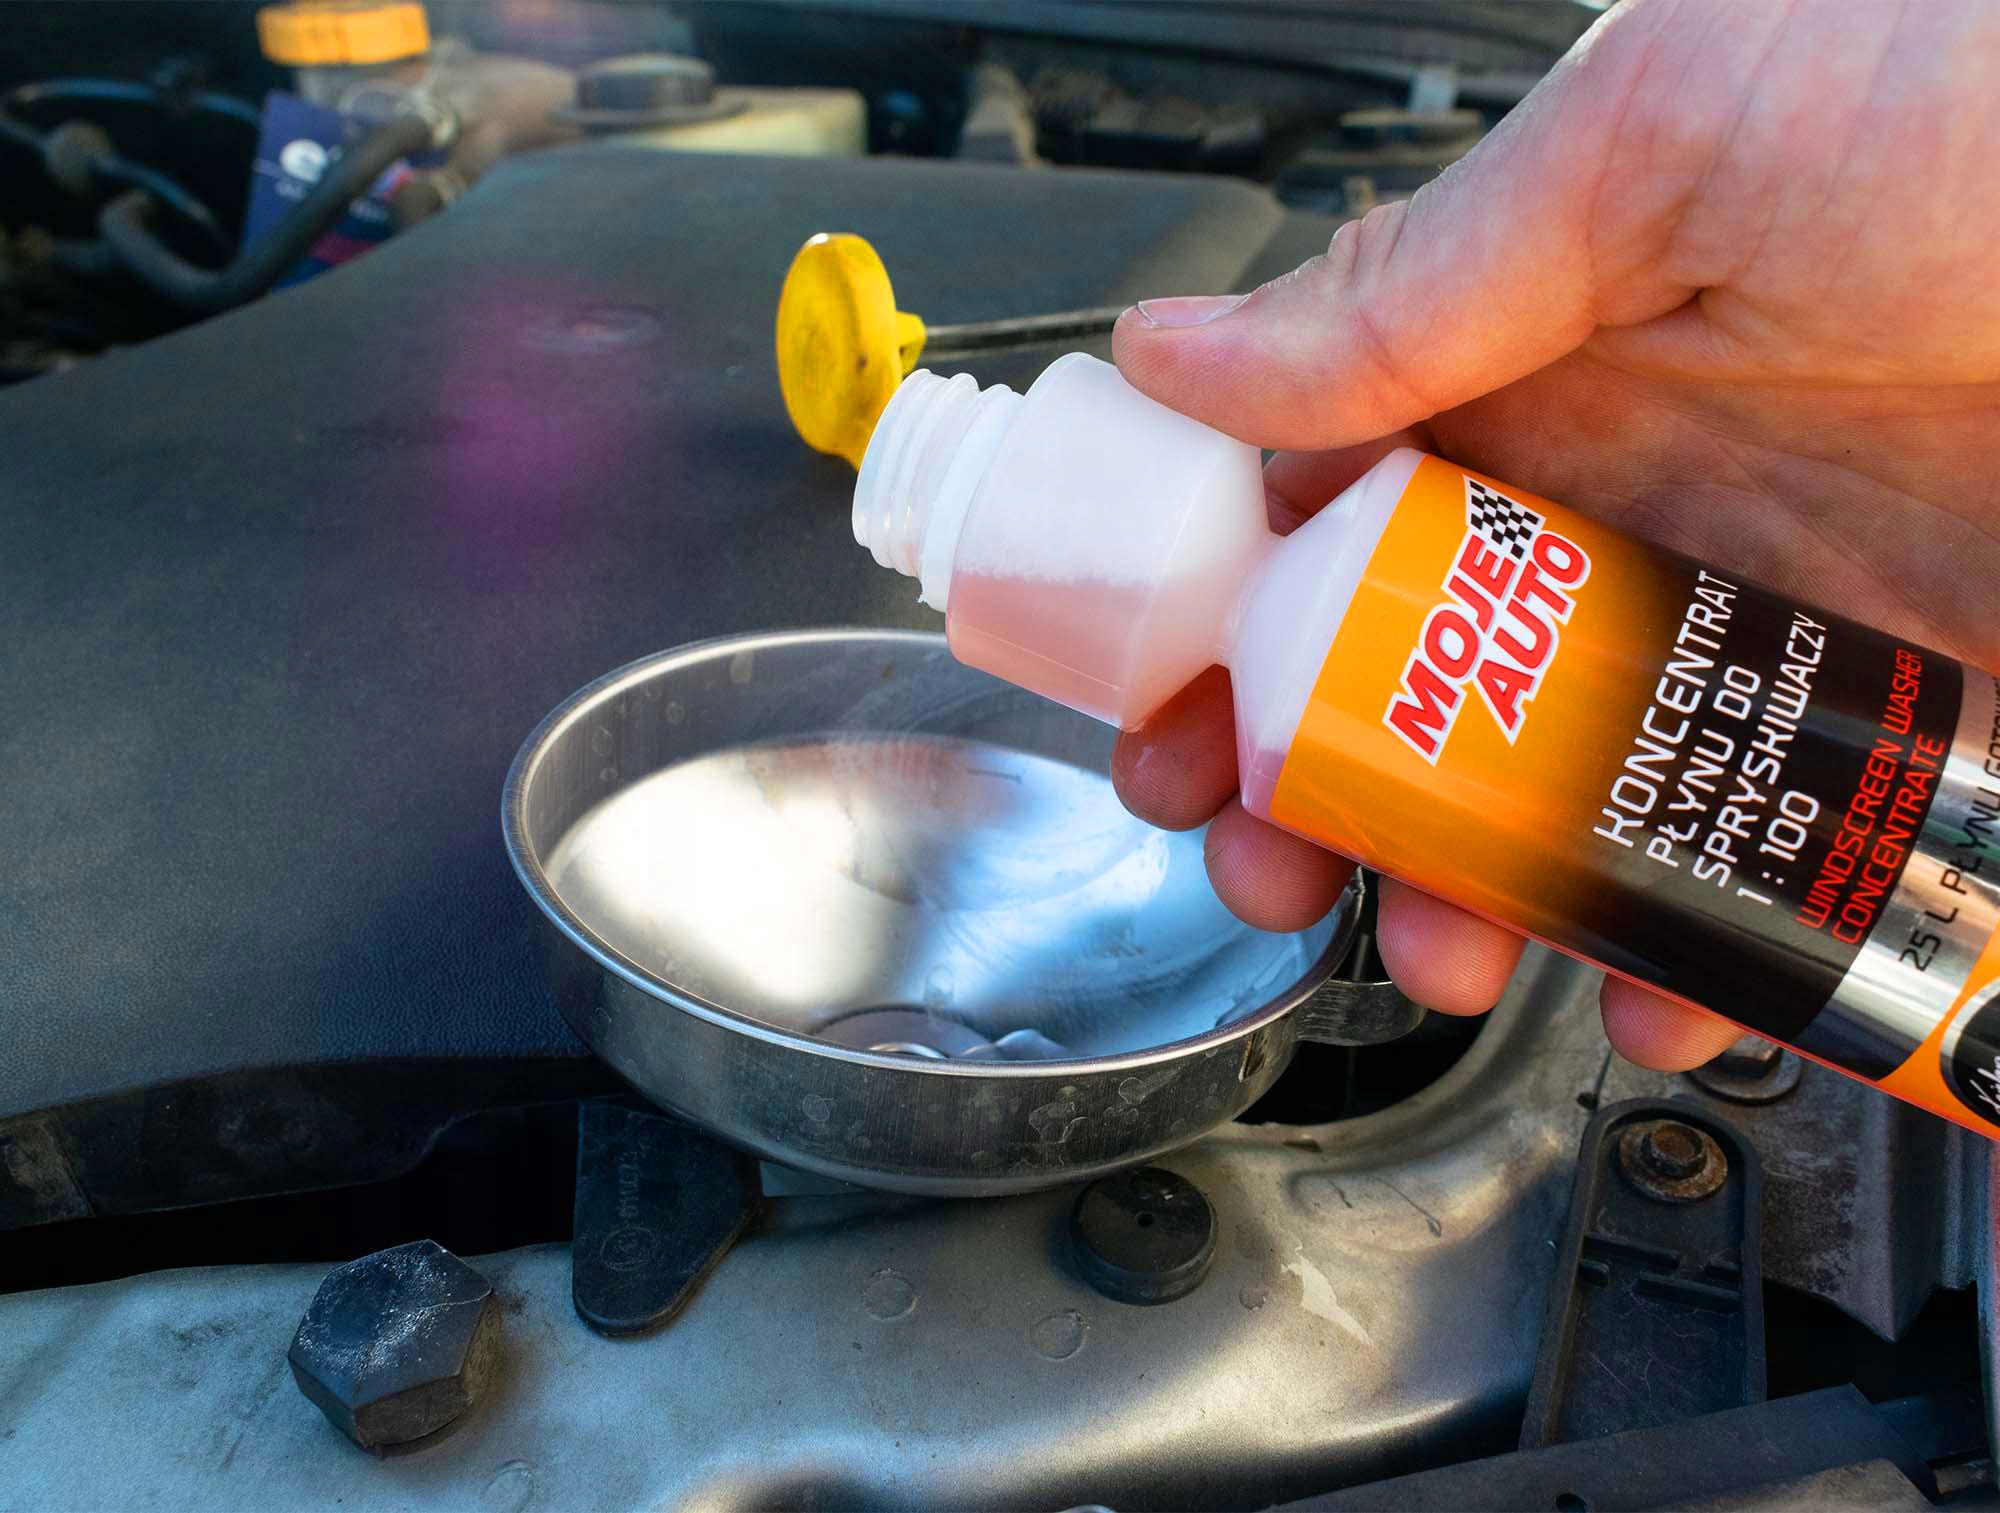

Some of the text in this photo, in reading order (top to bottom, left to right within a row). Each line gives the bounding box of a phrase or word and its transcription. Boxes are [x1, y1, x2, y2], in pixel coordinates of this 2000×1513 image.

[1387, 533, 1518, 758] MOJE
[1475, 532, 1587, 734] AUTO
[1593, 570, 1738, 848] KONCENTRAT
[1646, 664, 1761, 868] PŁYNU DO
[1692, 611, 1827, 888] SPRYSKIWACZY
[1736, 886, 1773, 906] 1
[1759, 789, 1820, 862] 100
[1796, 648, 1923, 929] WINDSCREEN WASHER
[1831, 732, 1946, 945] CONCENTRATE
[1900, 785, 2000, 973] 25 L PŁYNU
